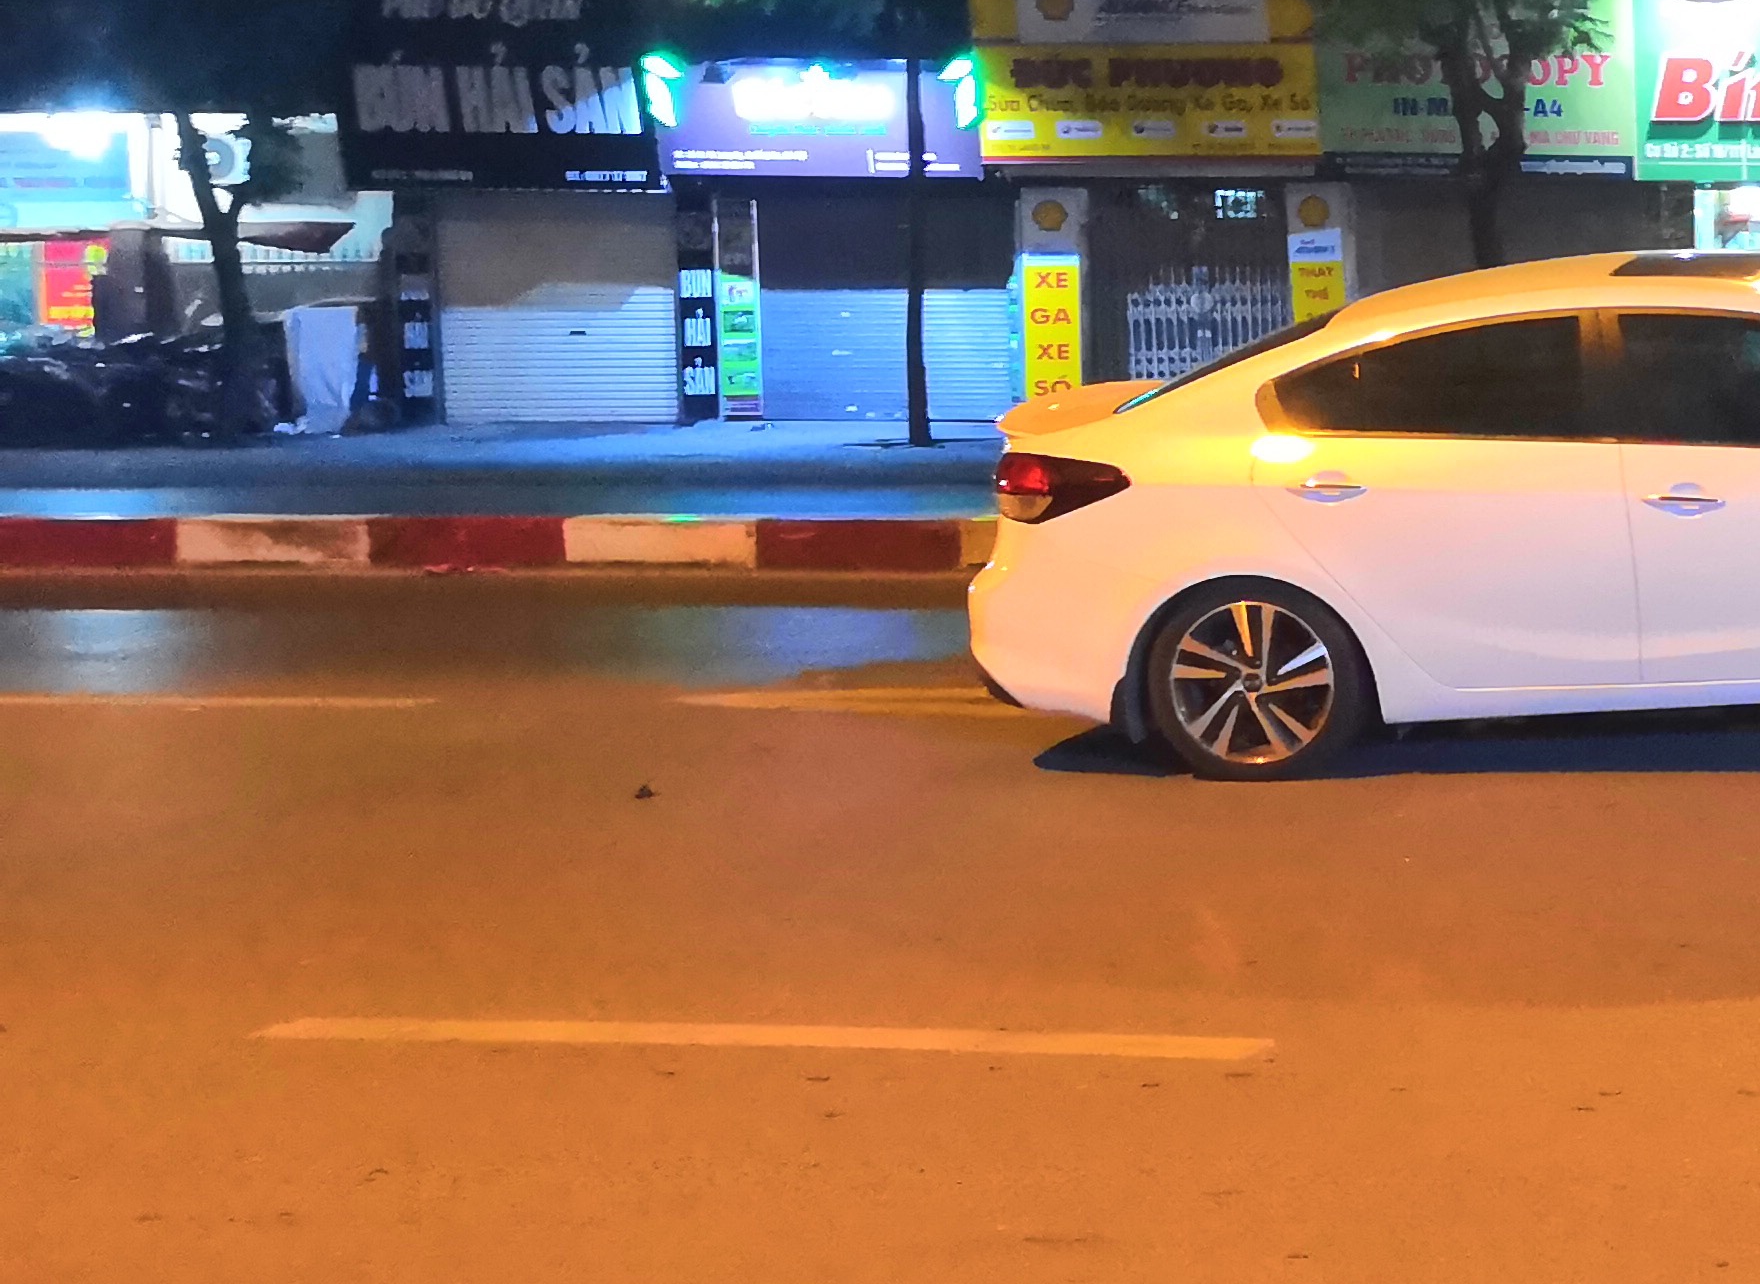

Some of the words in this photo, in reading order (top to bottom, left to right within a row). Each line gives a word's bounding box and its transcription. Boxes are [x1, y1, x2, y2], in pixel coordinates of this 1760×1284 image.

[456, 41, 539, 134] HẢI
[541, 42, 644, 135] SẢN
[1035, 271, 1069, 289] XE
[1030, 308, 1072, 325] GA
[1037, 343, 1071, 361] XE
